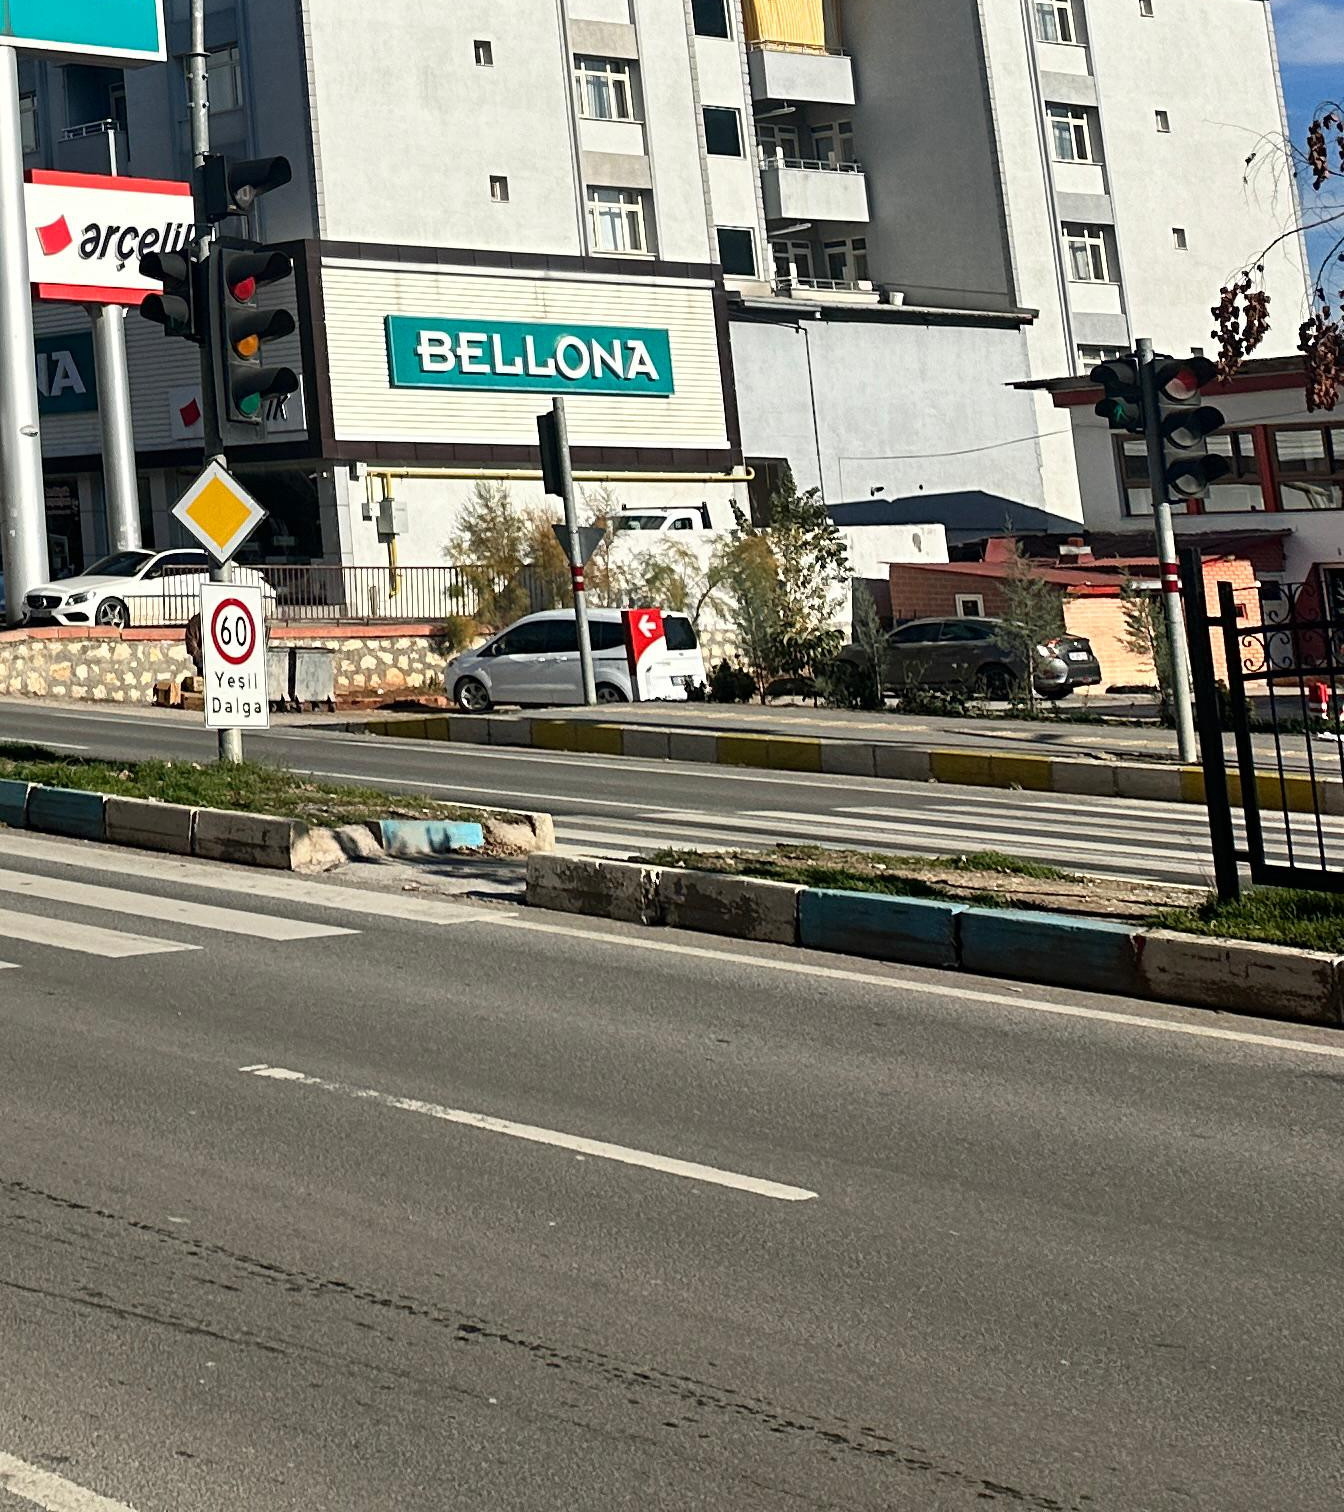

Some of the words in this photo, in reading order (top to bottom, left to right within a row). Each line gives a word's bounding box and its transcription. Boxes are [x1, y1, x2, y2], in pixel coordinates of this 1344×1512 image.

[417, 330, 660, 380] BELLONA
[220, 615, 247, 647] 60
[215, 671, 258, 690] Yeşil
[212, 696, 262, 718] Dalga
